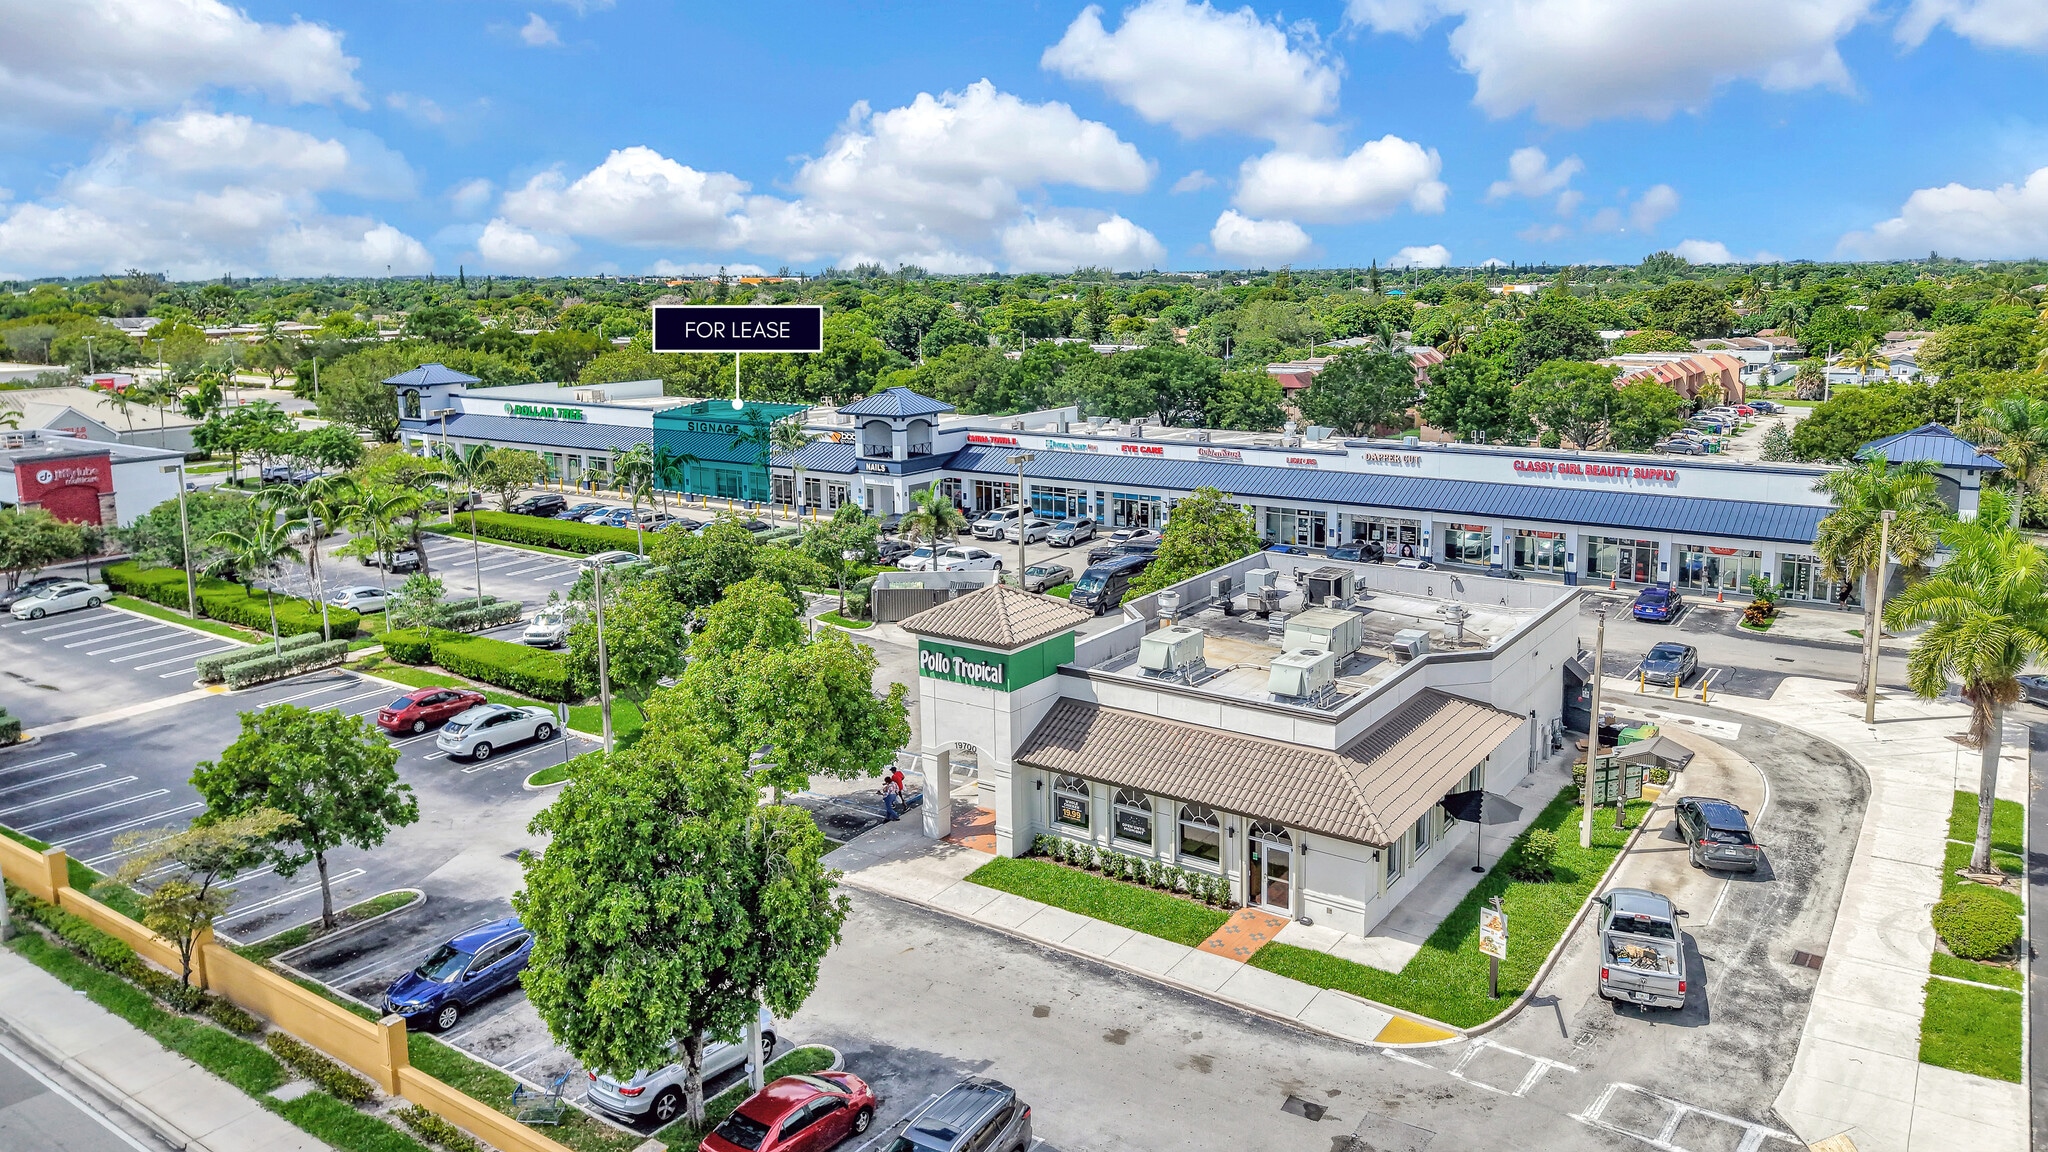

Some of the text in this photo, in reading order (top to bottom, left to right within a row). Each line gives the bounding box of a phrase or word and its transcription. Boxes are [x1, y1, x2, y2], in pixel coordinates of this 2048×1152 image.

[514, 404, 583, 420] DOLLAR TREE
[1121, 445, 1164, 454] EYE CARE
[1365, 452, 1421, 464] DAPPER CUT
[866, 463, 886, 472] NAILS
[1513, 460, 1677, 481] CLASSY GIRL BEAUTY SUPPLY
[920, 649, 1003, 684] Pollo Tropical
[954, 741, 977, 753] 19700
